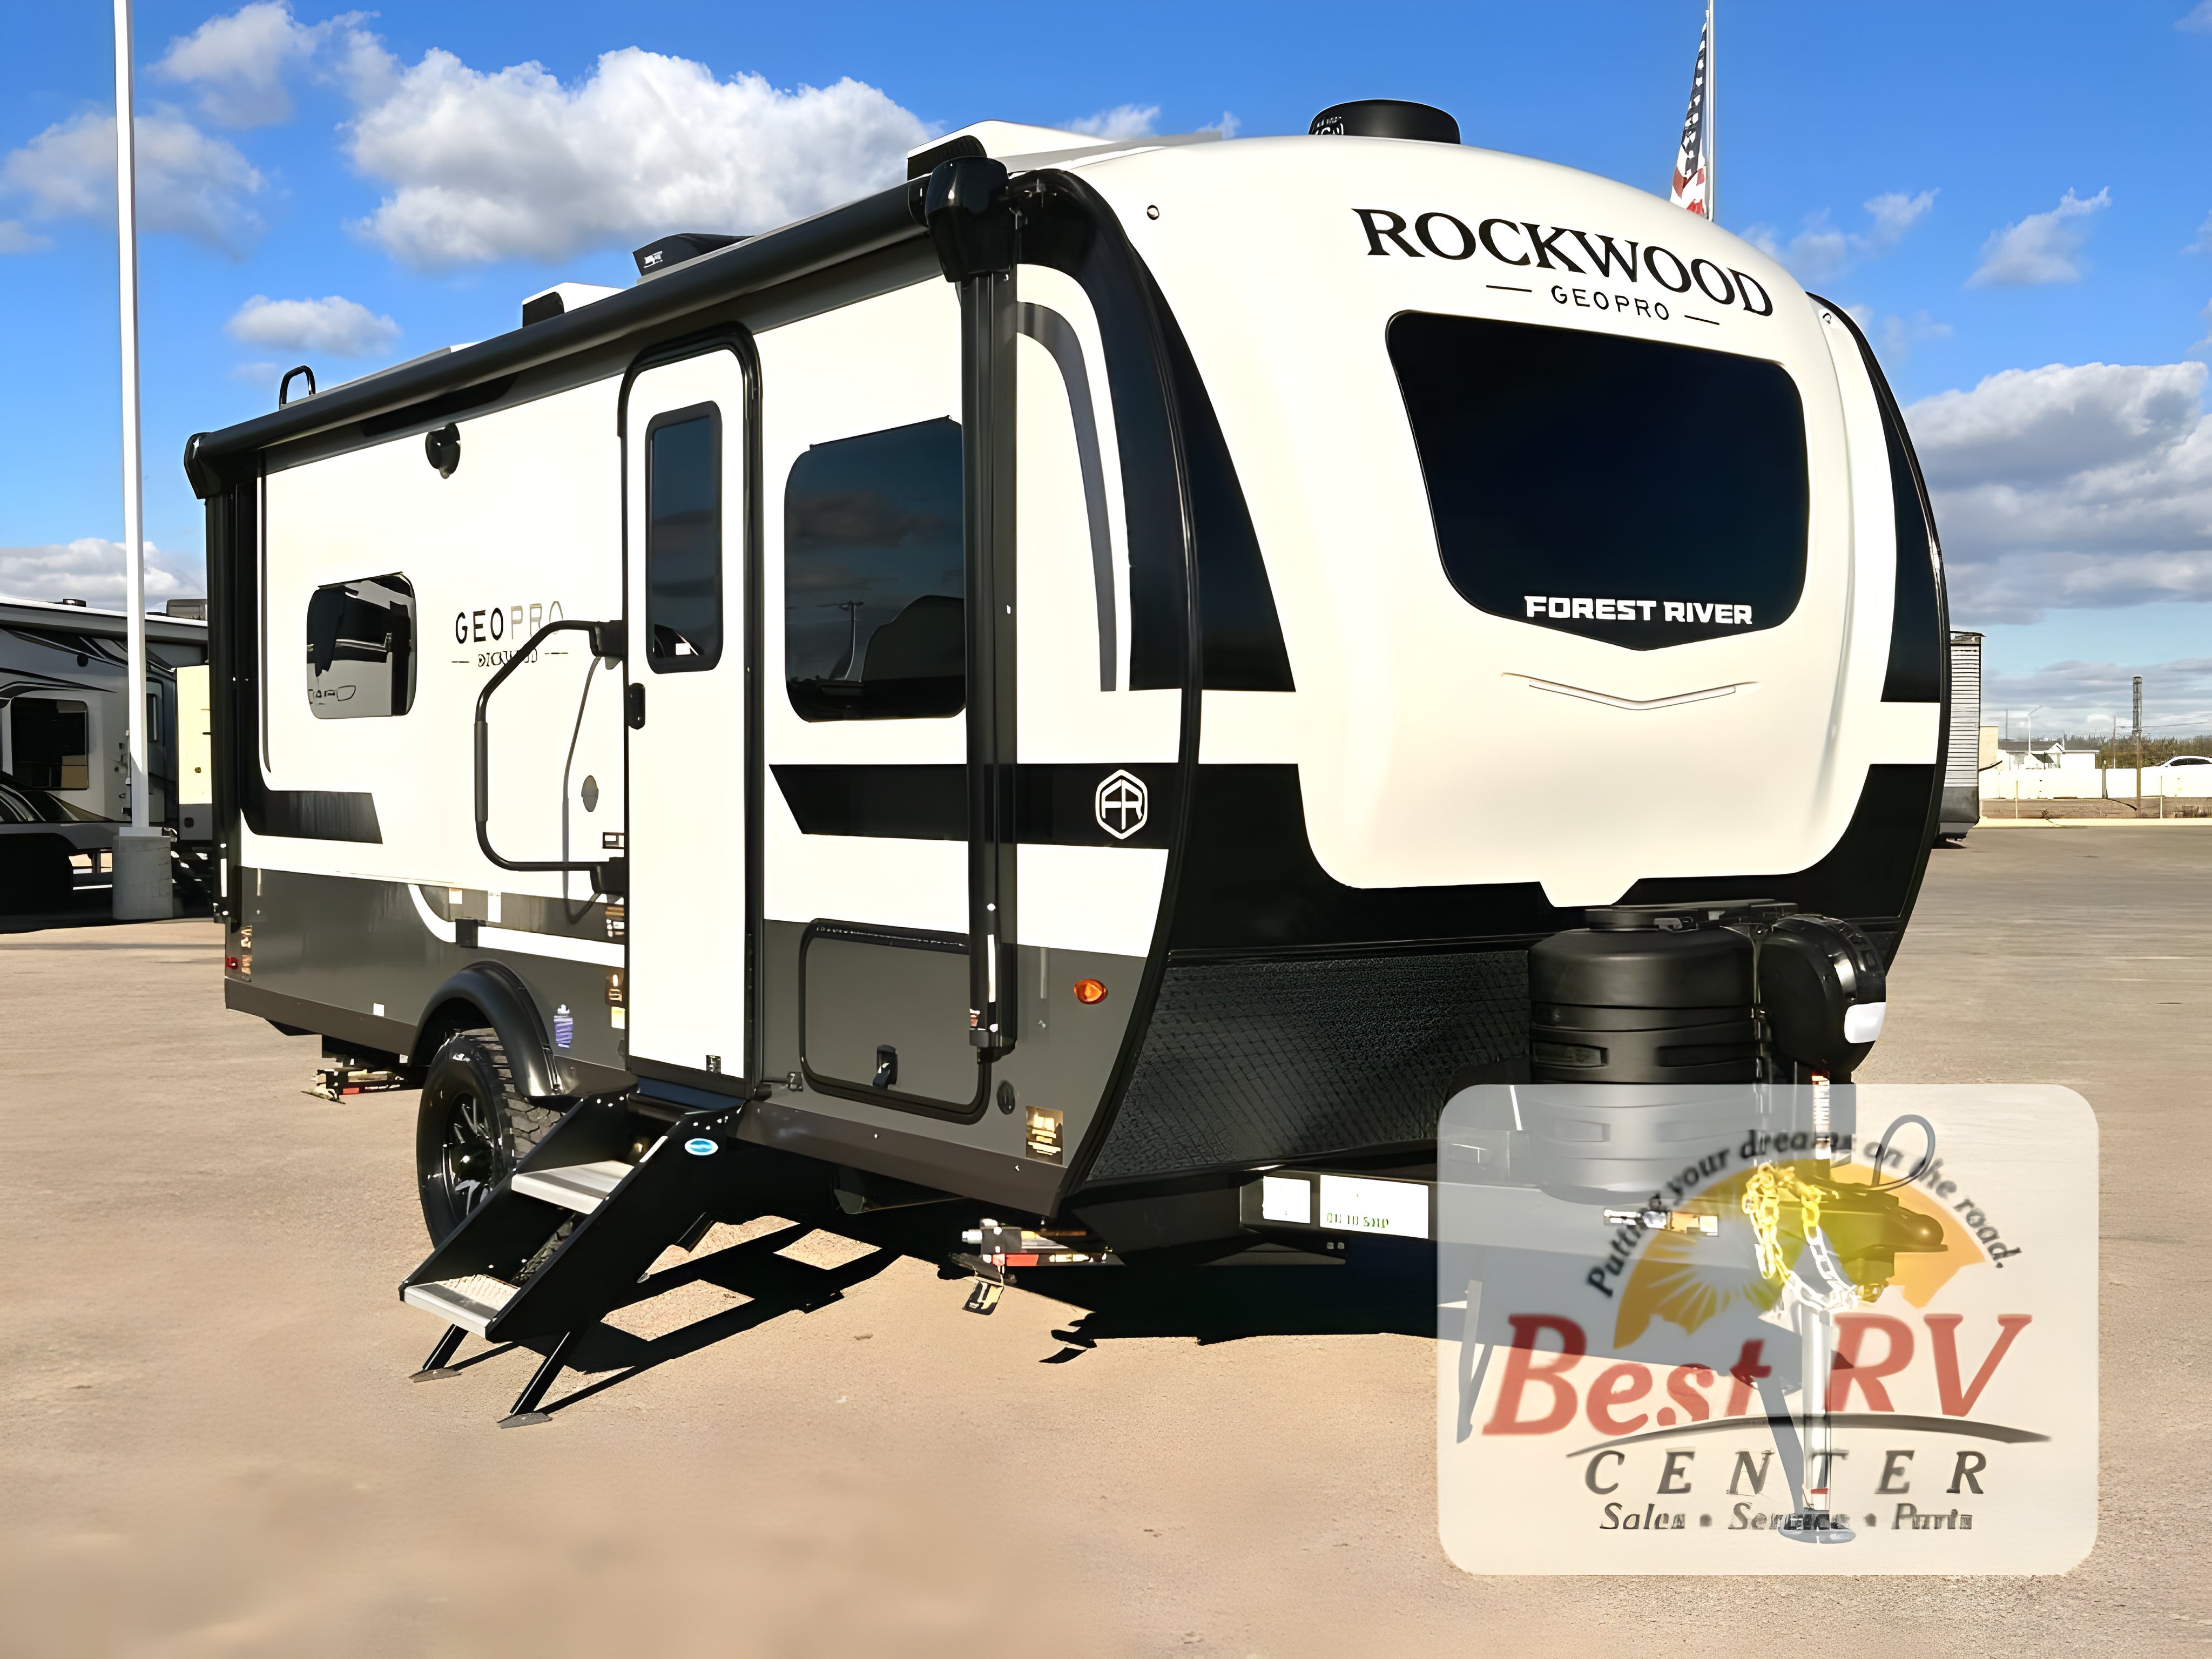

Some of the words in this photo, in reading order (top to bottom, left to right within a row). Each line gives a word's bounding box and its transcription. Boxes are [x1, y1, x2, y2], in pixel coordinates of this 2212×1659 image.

[1352, 208, 1773, 317] ROCKWOOD
[1550, 285, 1670, 321] GEOPRO
[455, 601, 564, 644] GEOPRO
[1524, 596, 1656, 621] FOREST
[1663, 601, 1752, 625] RIVER
